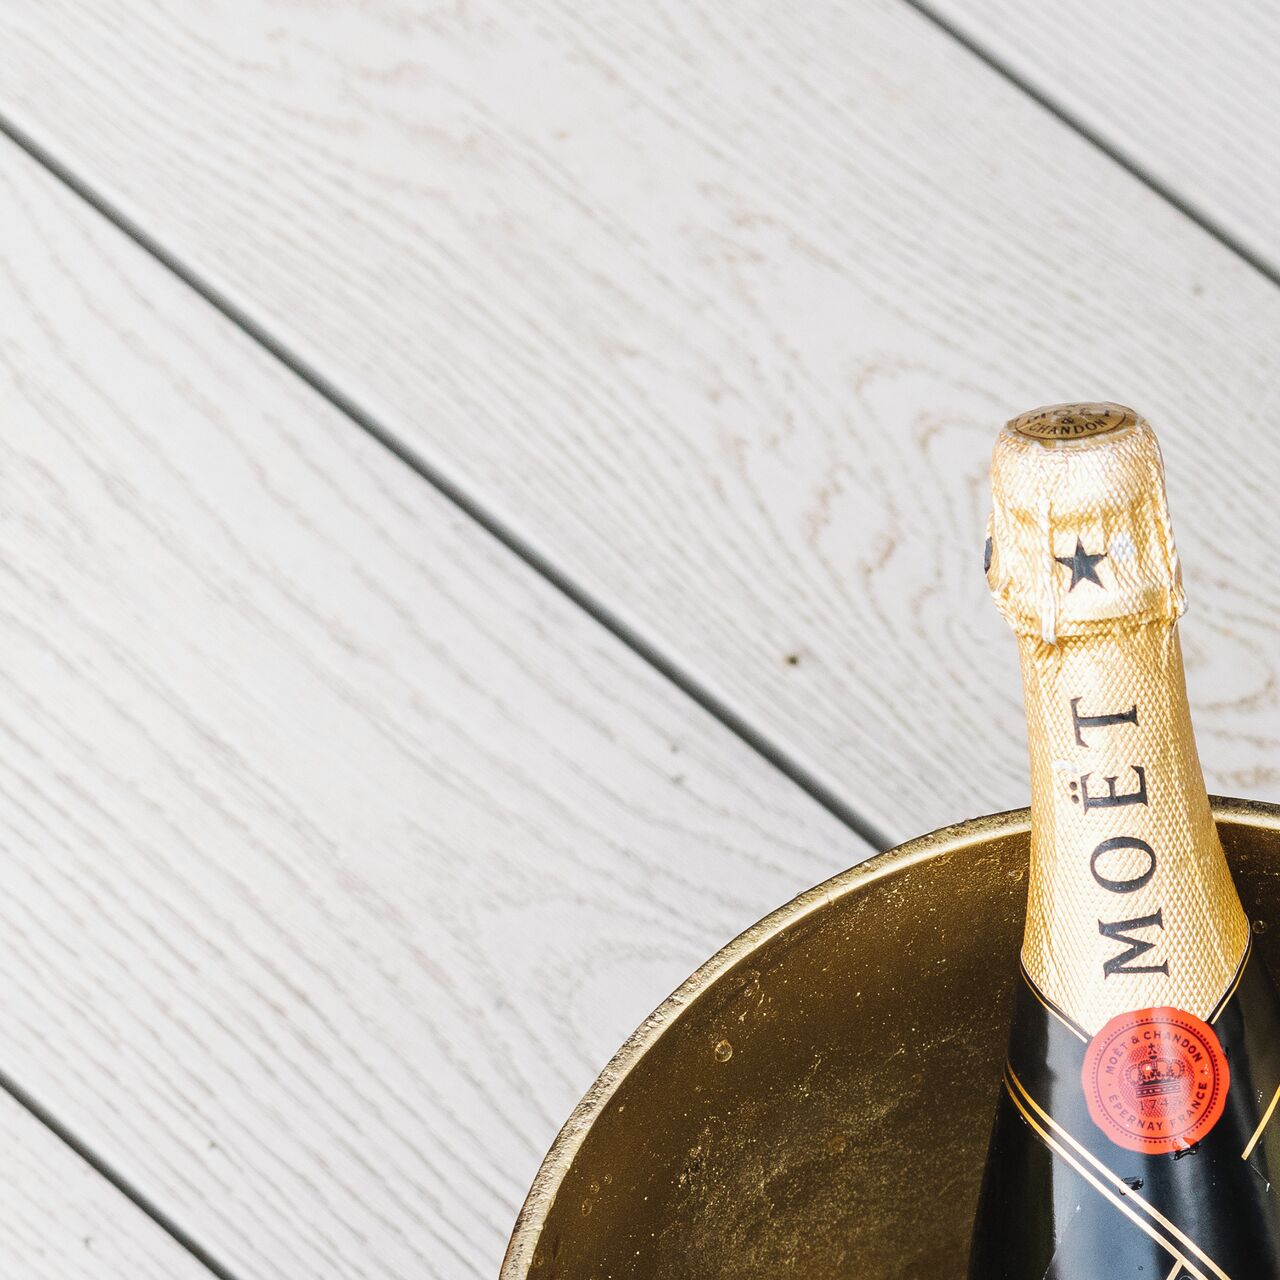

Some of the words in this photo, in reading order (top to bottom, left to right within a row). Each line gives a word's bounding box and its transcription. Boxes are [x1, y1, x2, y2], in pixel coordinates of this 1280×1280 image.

[1028, 418, 1108, 434] CHANDON
[1069, 696, 1170, 979] MOËT
[1131, 1035, 1140, 1045] &
[1143, 1030, 1204, 1063] CHANDON
[1169, 1081, 1208, 1129] FRANCE
